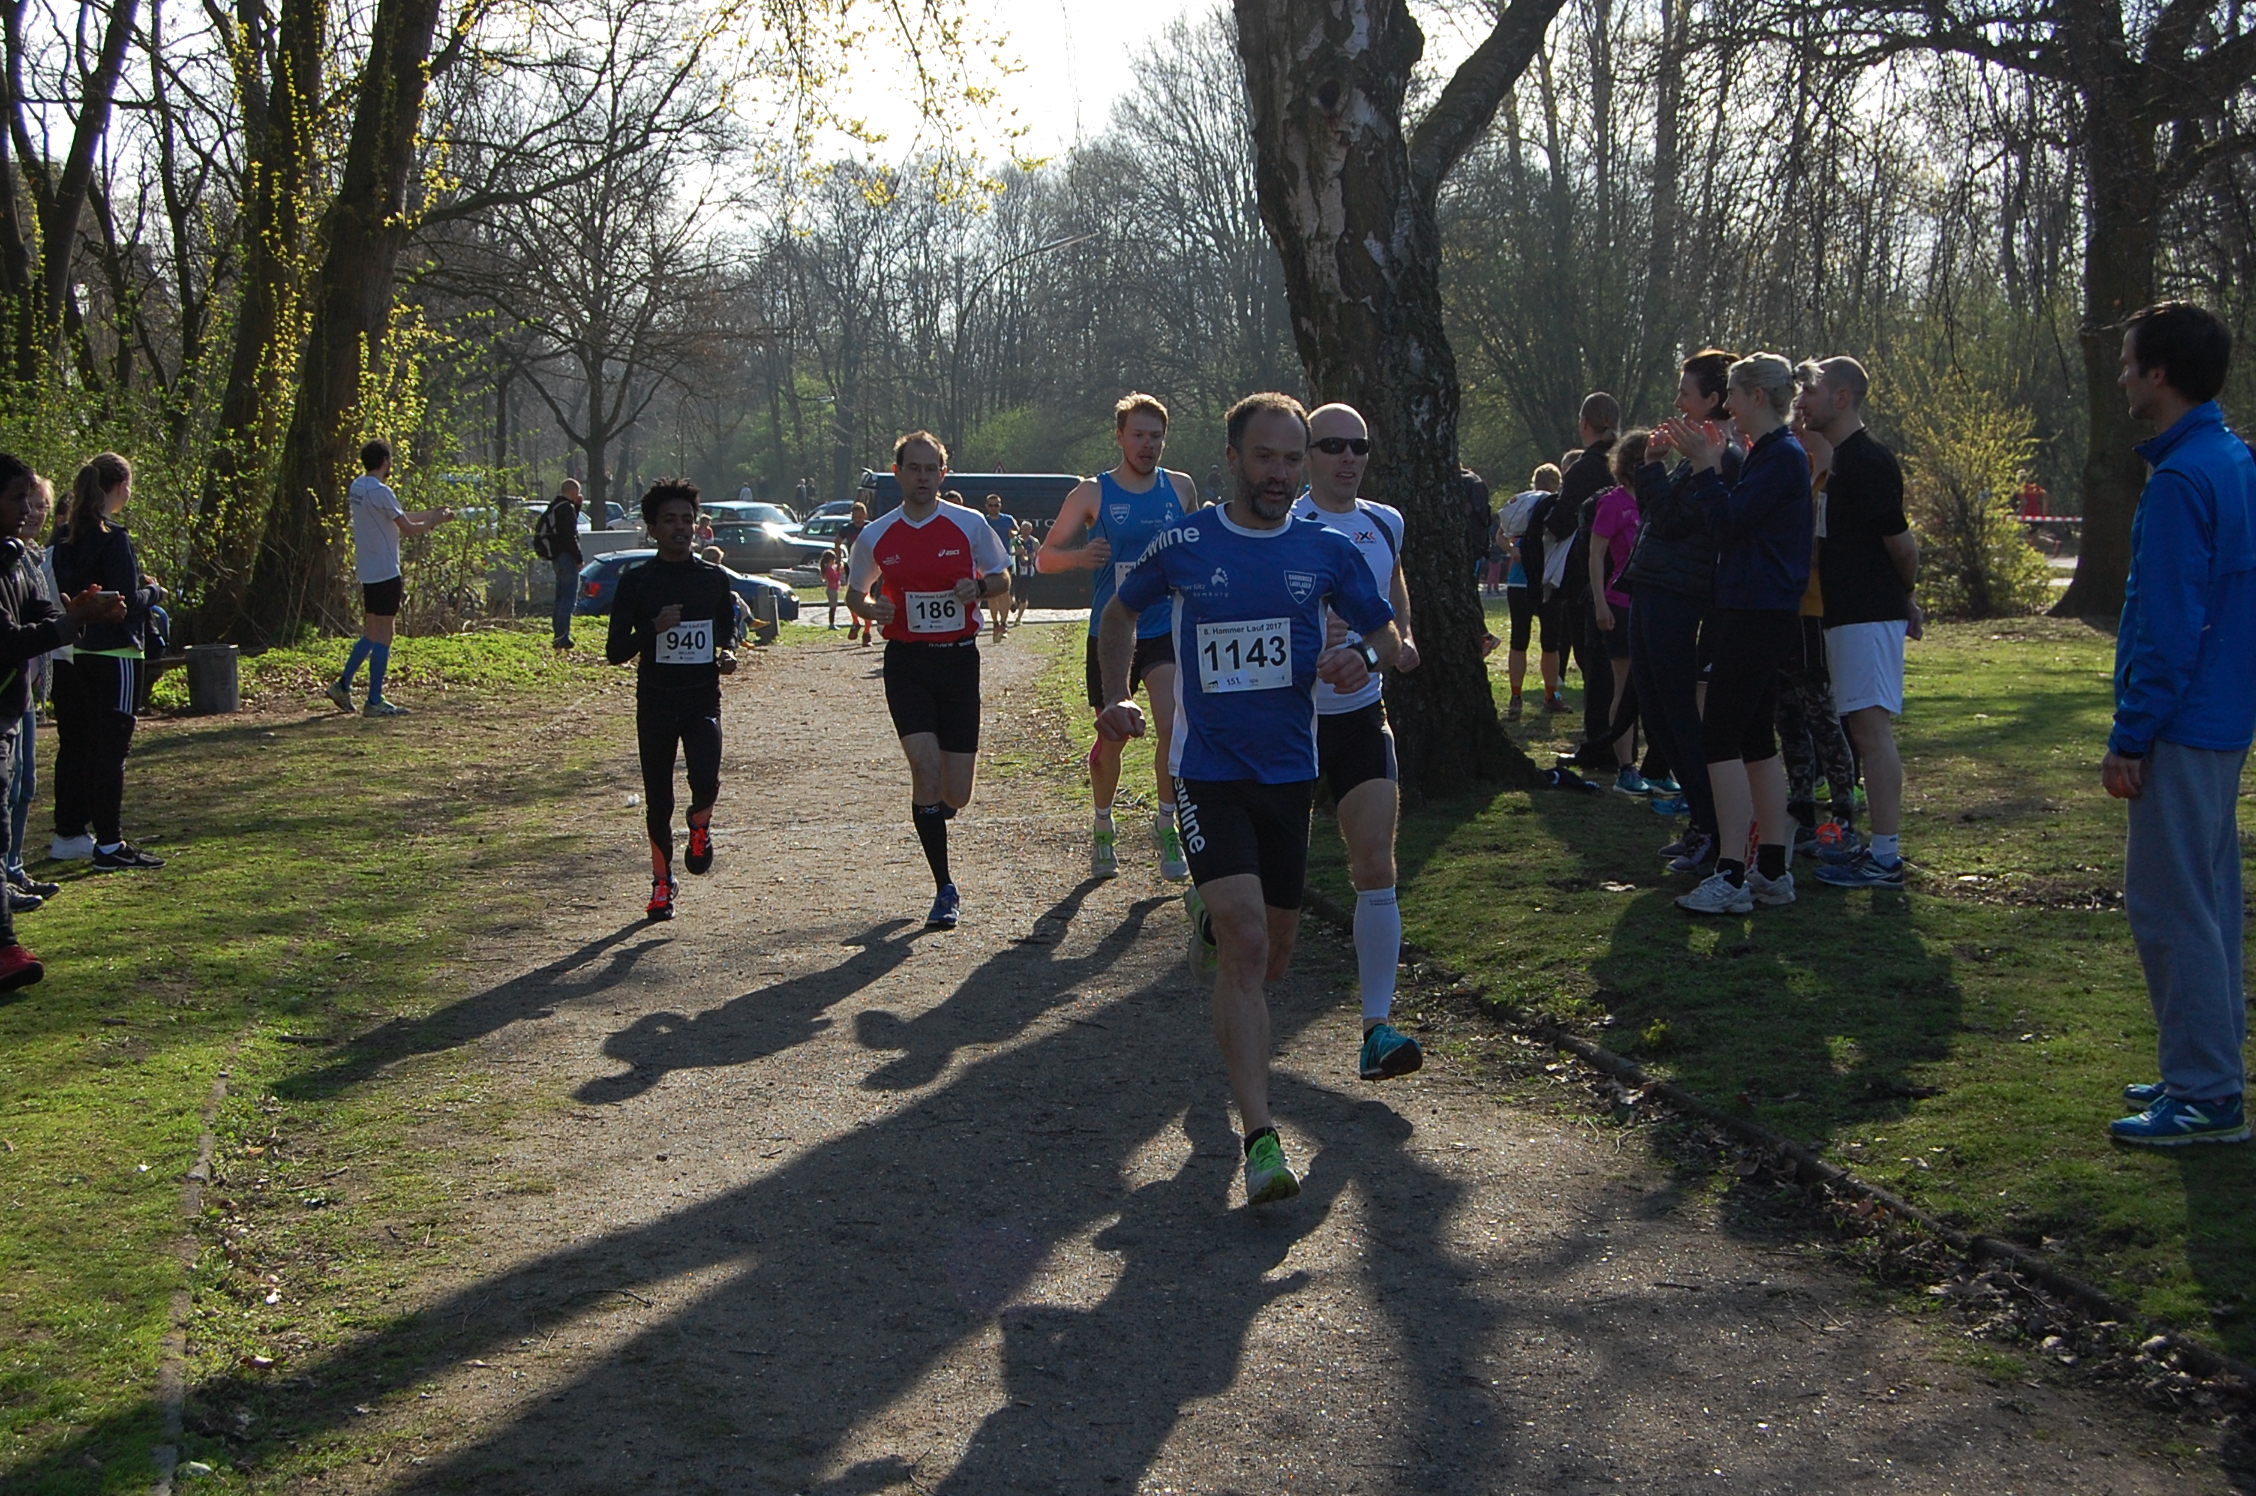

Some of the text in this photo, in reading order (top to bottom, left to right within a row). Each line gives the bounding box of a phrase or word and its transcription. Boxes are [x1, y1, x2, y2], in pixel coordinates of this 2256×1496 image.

[916, 600, 956, 619] 186
[1212, 626, 1245, 635] Hammer
[1246, 624, 1265, 633] Lauf
[1265, 622, 1283, 631] 2017
[666, 630, 706, 650] 940
[1204, 635, 1287, 672] 1143
